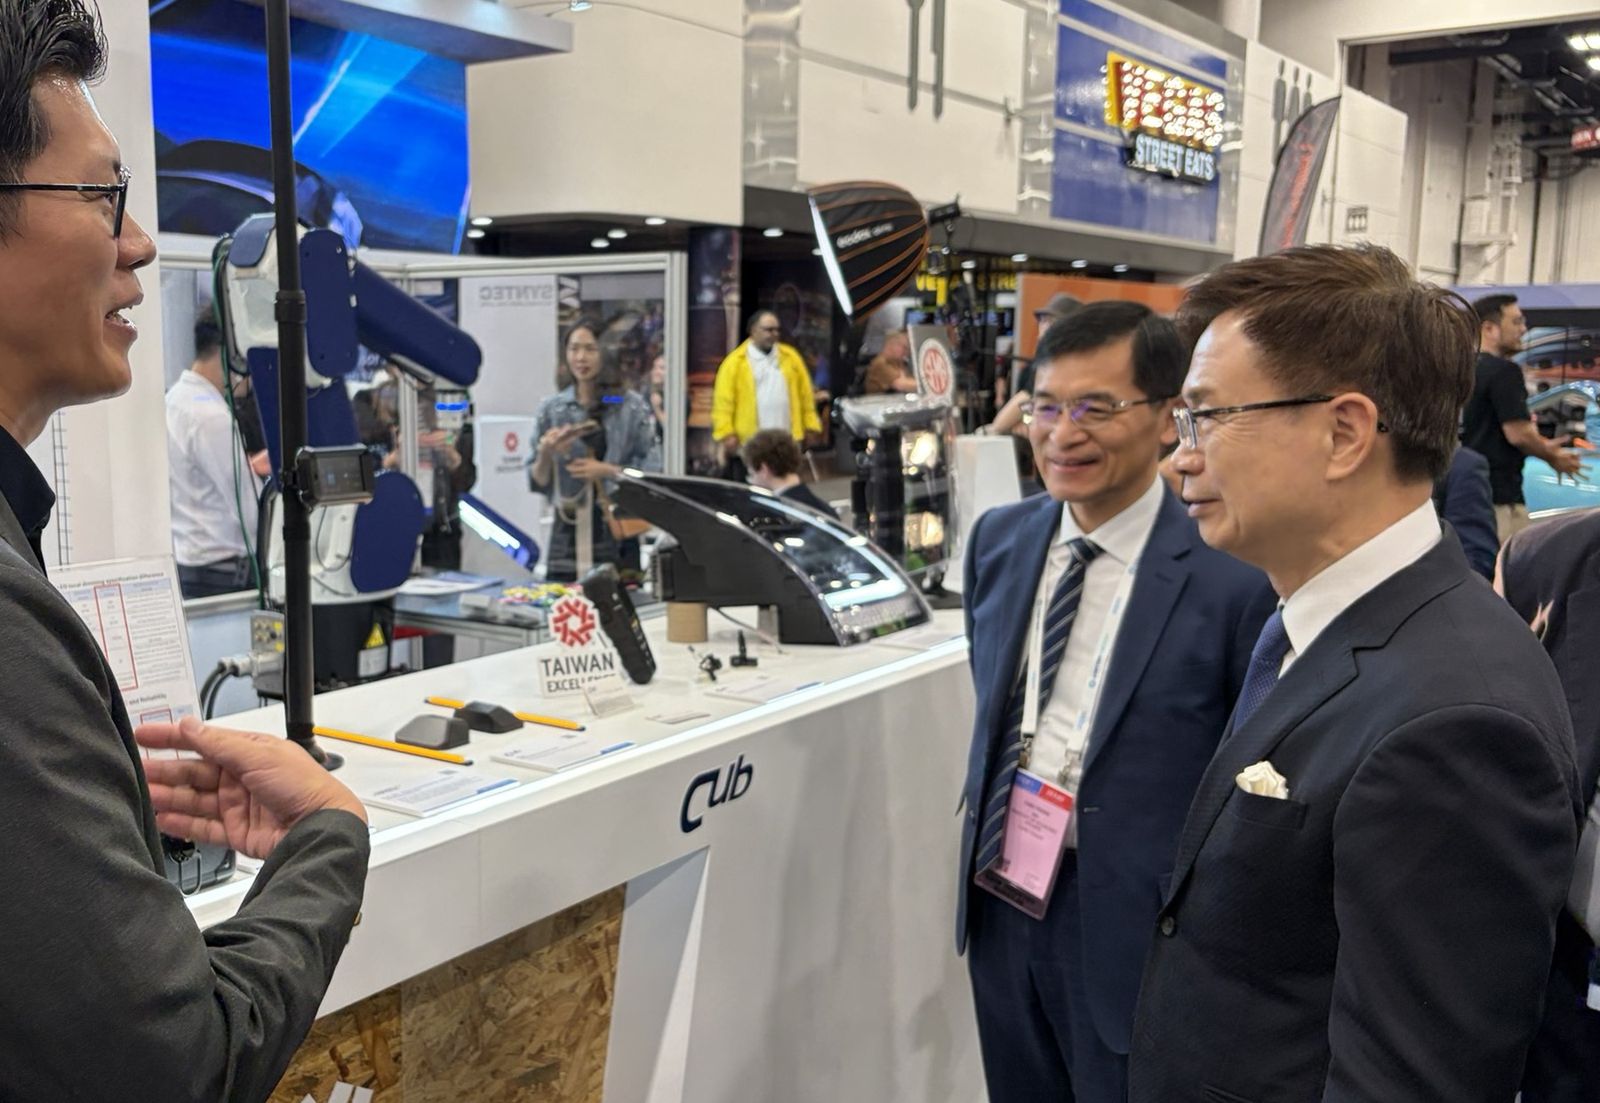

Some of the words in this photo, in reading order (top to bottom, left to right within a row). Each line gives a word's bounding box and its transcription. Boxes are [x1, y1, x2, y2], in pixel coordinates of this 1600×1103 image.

[1135, 133, 1184, 174] STREET
[1184, 148, 1216, 181] EATS
[541, 652, 615, 677] TAIWAN
